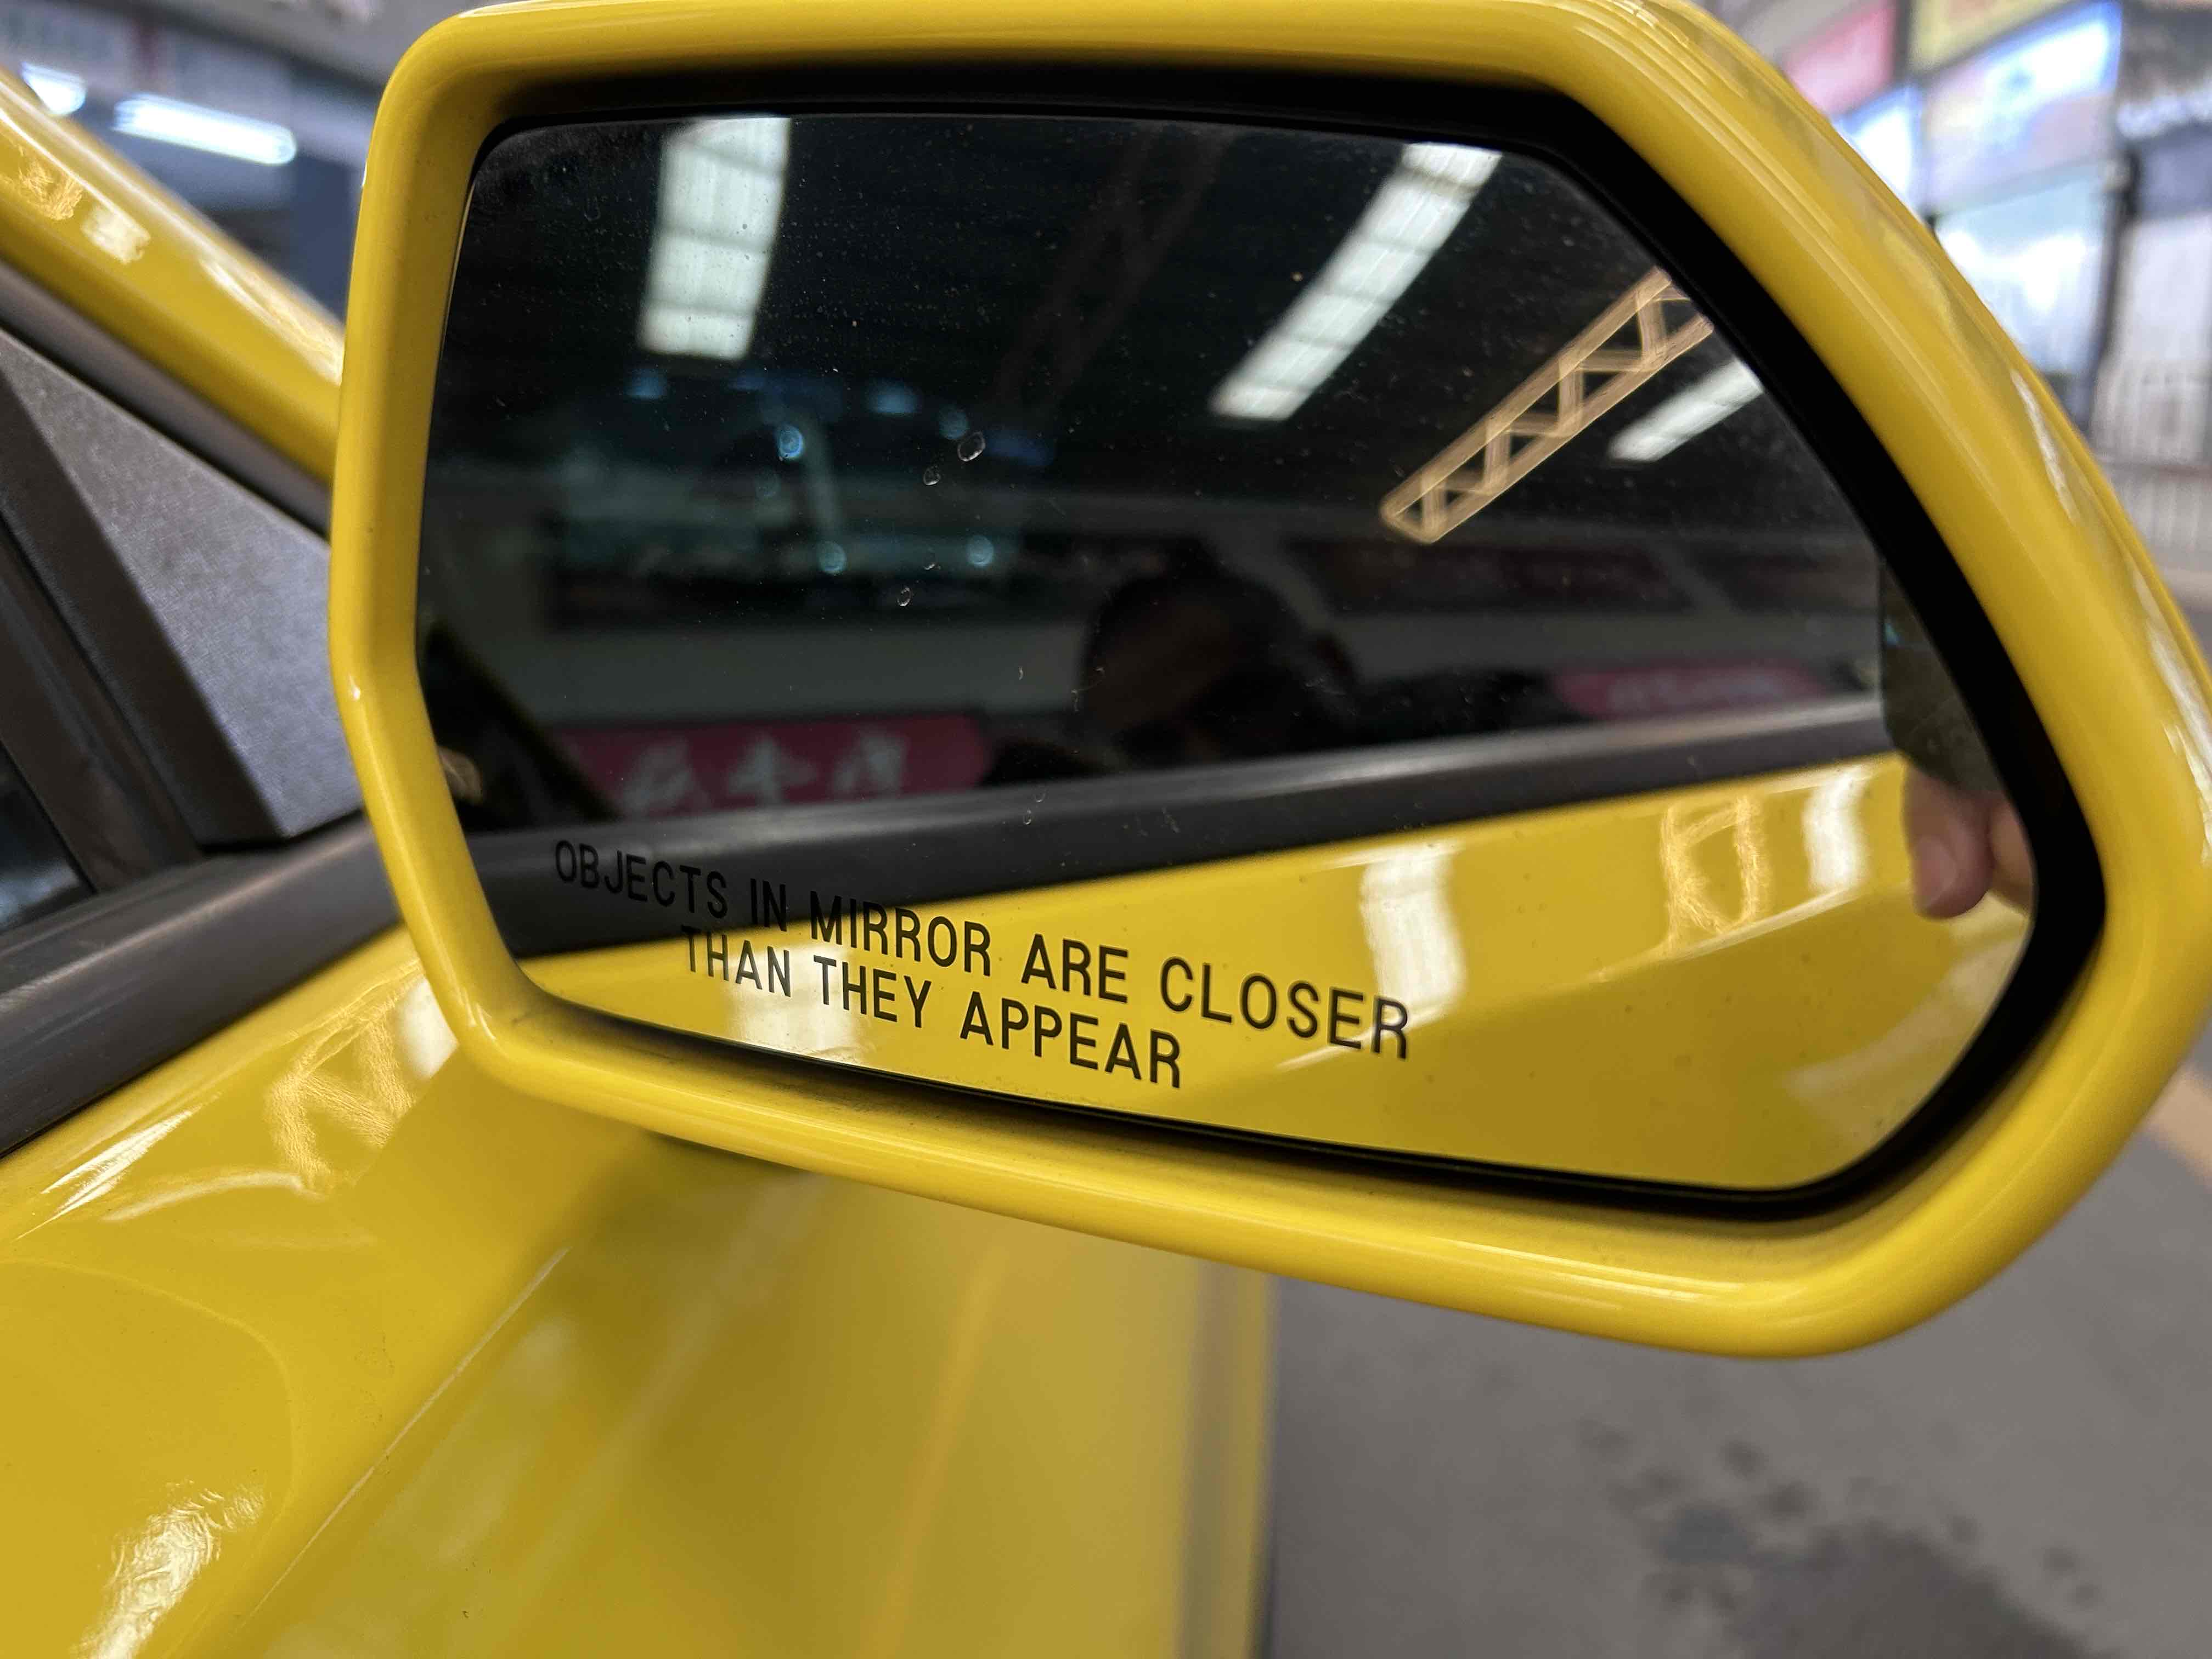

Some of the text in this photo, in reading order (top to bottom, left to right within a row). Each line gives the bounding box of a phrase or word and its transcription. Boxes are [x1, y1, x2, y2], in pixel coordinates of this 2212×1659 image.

[555, 840, 1408, 1059] OBJECTS IN MIRROR ARE CLOSER
[681, 924, 1180, 1088] THAN THEY APPEAR
